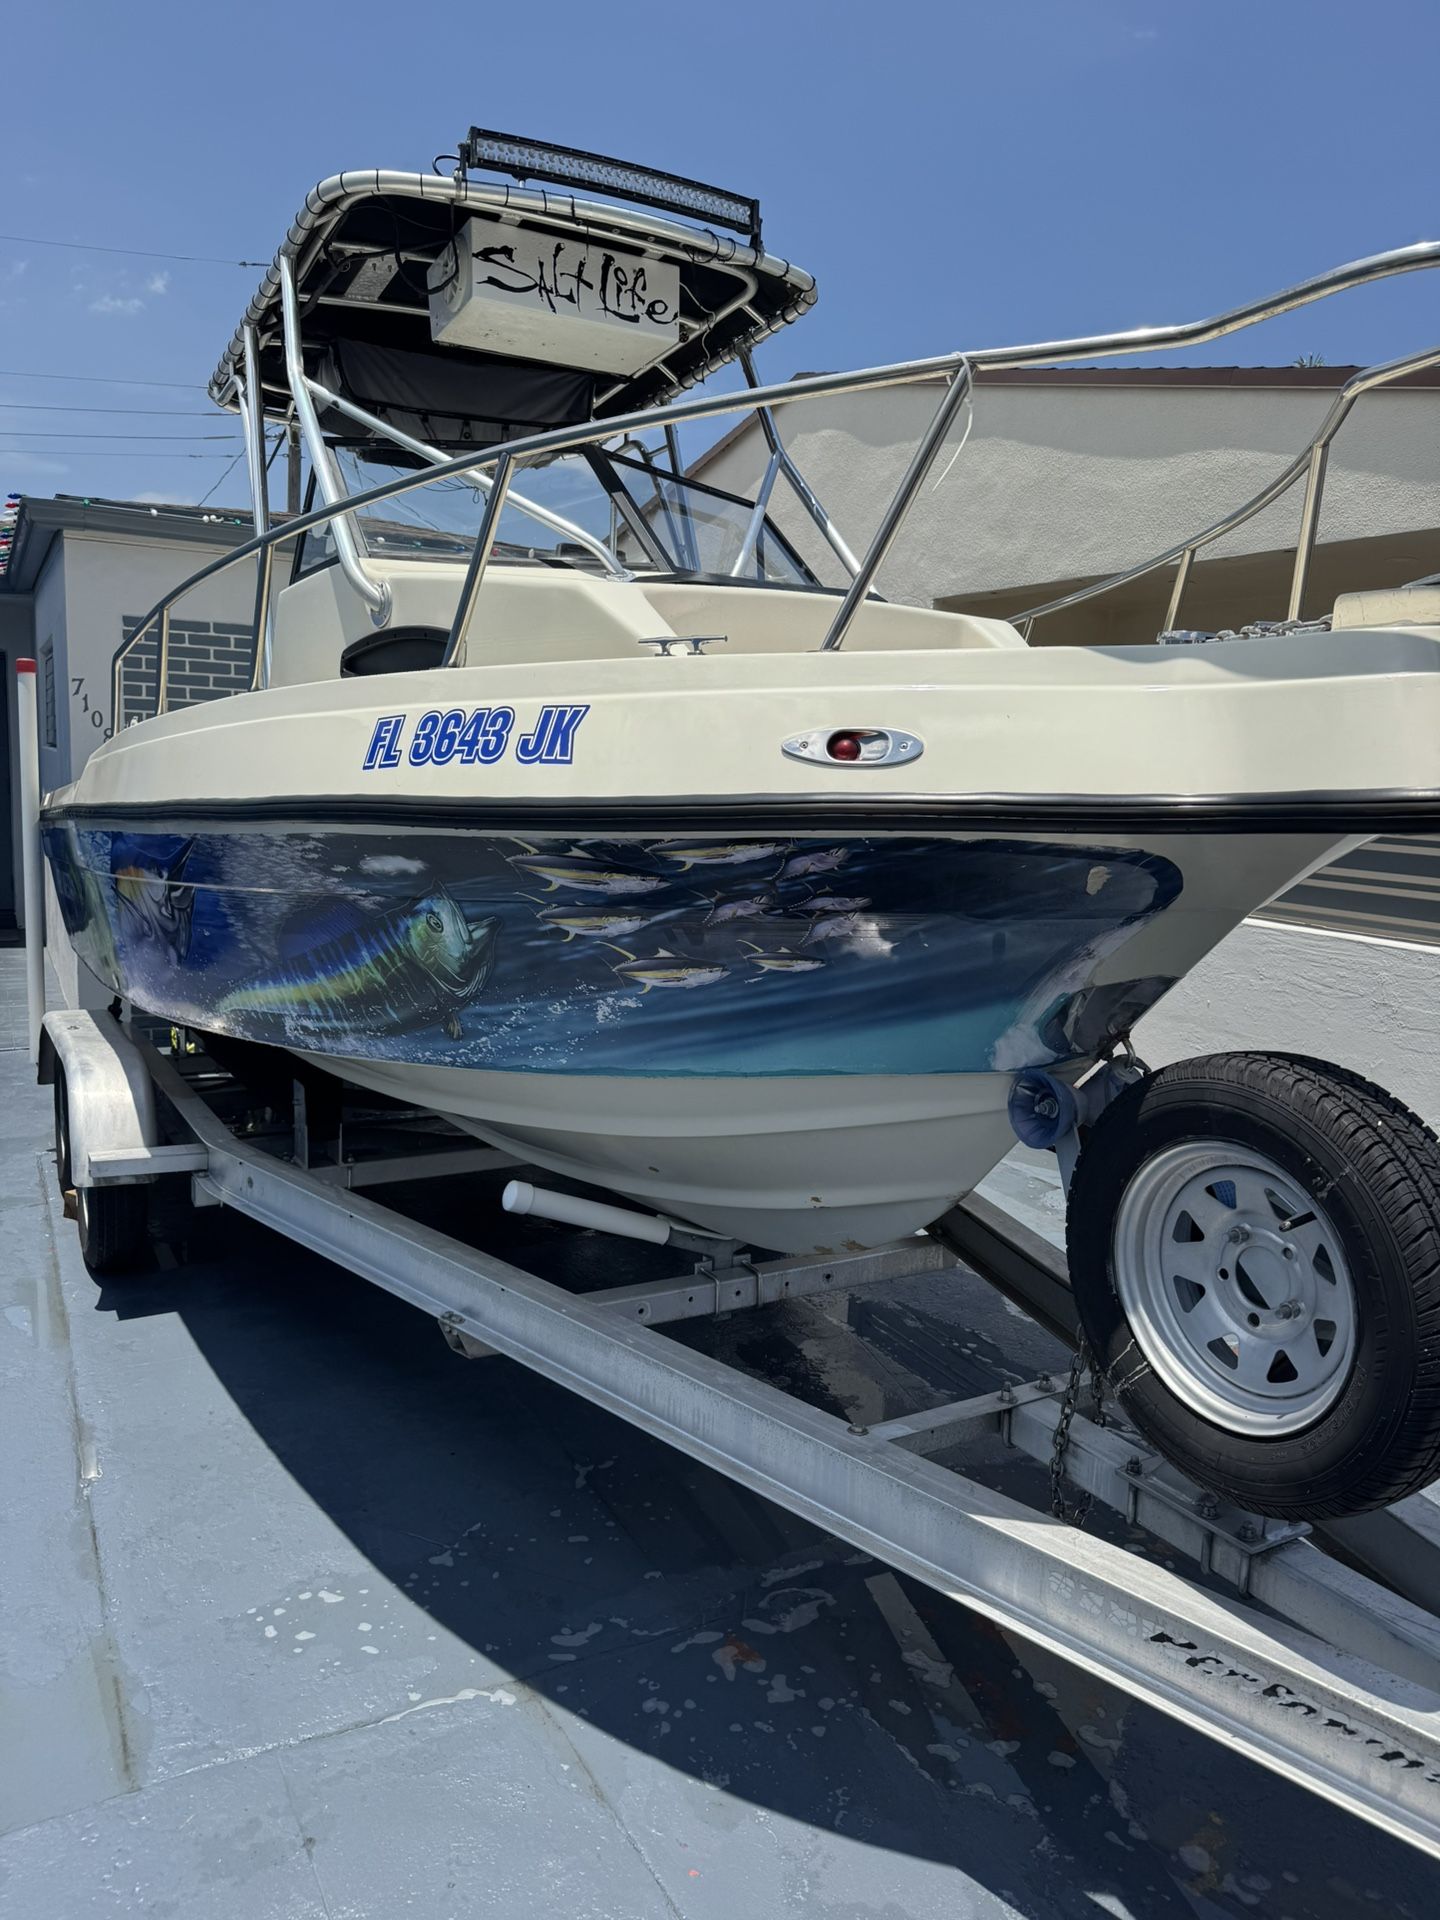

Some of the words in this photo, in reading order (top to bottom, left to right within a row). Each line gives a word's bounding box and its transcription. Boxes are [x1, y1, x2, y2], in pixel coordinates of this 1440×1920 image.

[362, 714, 406, 770] FL
[408, 706, 515, 767] 3643
[516, 704, 591, 765] JK
